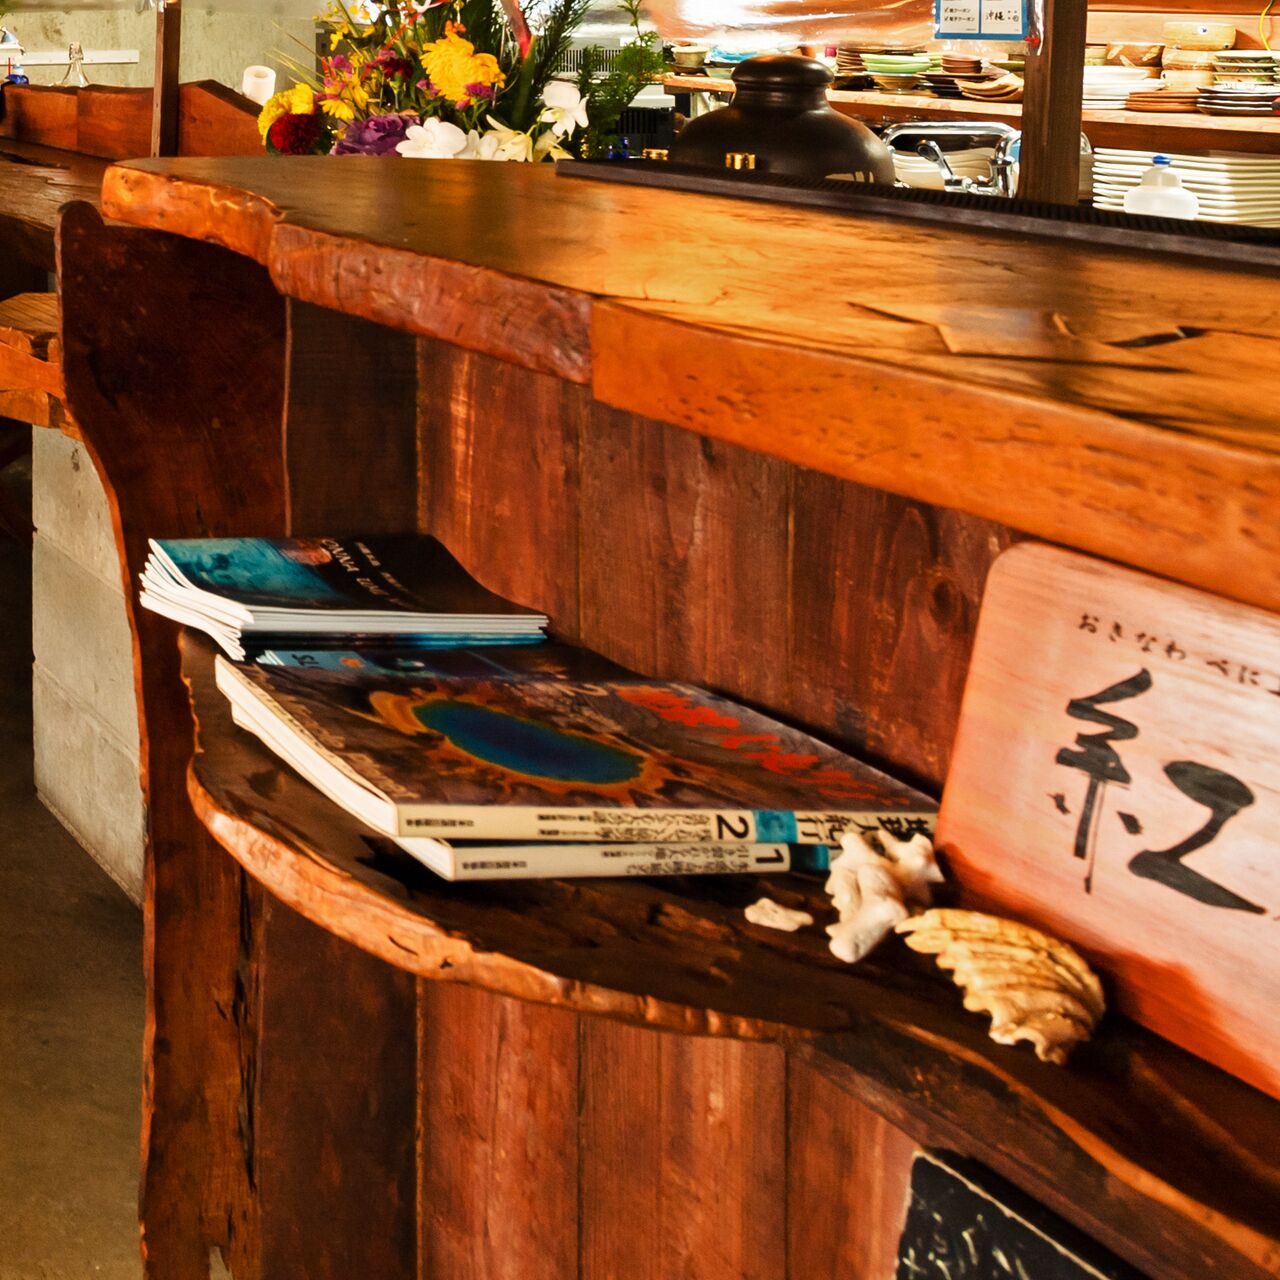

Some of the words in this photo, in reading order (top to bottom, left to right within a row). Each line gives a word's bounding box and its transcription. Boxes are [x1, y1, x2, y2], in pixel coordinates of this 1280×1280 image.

[1078, 613, 1186, 661] おきなわ
[715, 814, 750, 840] 2
[756, 849, 784, 864] 1
